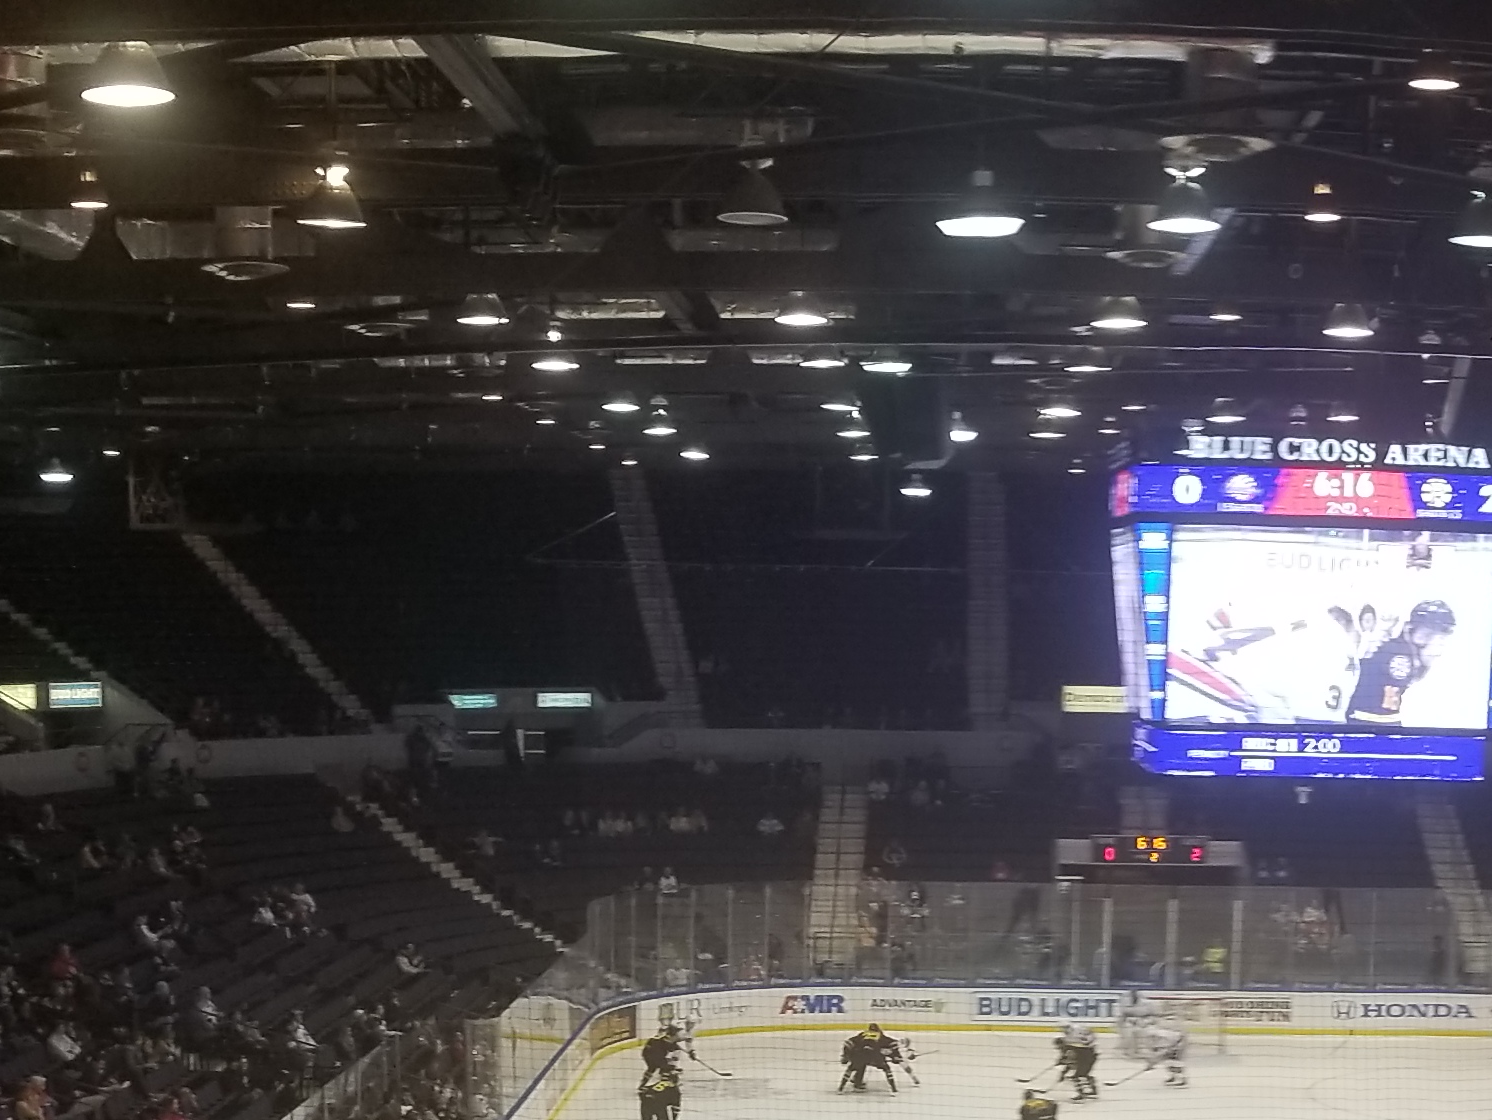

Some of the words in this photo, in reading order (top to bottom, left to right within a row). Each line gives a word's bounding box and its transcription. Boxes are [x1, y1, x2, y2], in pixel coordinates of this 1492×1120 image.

[1188, 435, 1274, 460] BLUE
[1277, 436, 1377, 463] CROSS
[1384, 444, 1491, 469] ARENA
[1172, 475, 1203, 504] 0
[1312, 471, 1376, 498] 6:16
[1325, 501, 1357, 515] 2ND
[1302, 738, 1341, 753] 2:00
[1103, 846, 1116, 862] 0
[1190, 846, 1203, 862] 2
[779, 994, 845, 1014] AMR
[870, 998, 933, 1010] ADVANTAGE
[978, 996, 1032, 1017] BUD
[1041, 997, 1120, 1018] LIGHT
[1360, 1003, 1475, 1019] HONDA
